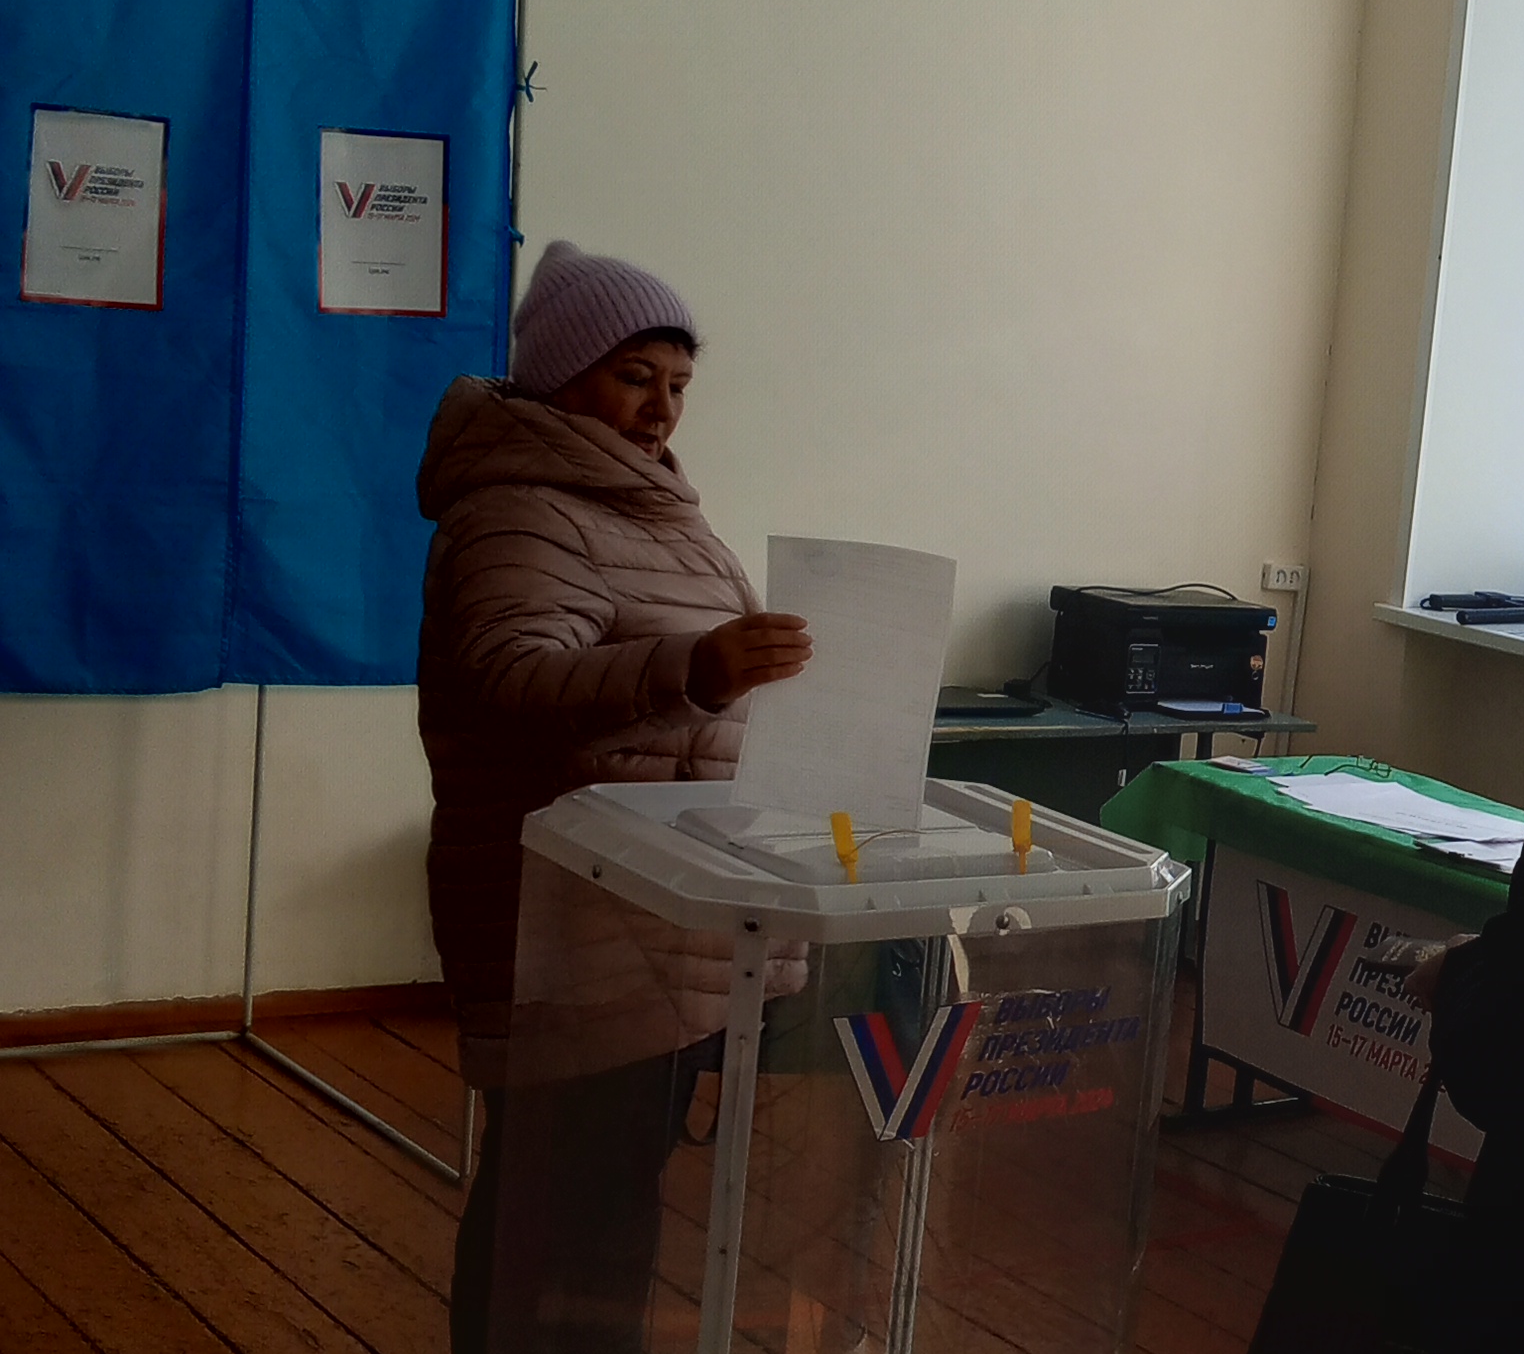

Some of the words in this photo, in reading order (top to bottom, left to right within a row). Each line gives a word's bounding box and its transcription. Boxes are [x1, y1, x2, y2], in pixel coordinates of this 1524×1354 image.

[994, 986, 1113, 1024] ВЫБОРЫ
[1334, 991, 1422, 1046] РОССИИ
[978, 1016, 1141, 1062] ПРЕЗИДЕНТА
[961, 1061, 1071, 1100] РОССИИ
[1366, 1041, 1419, 1081] МАРТА
